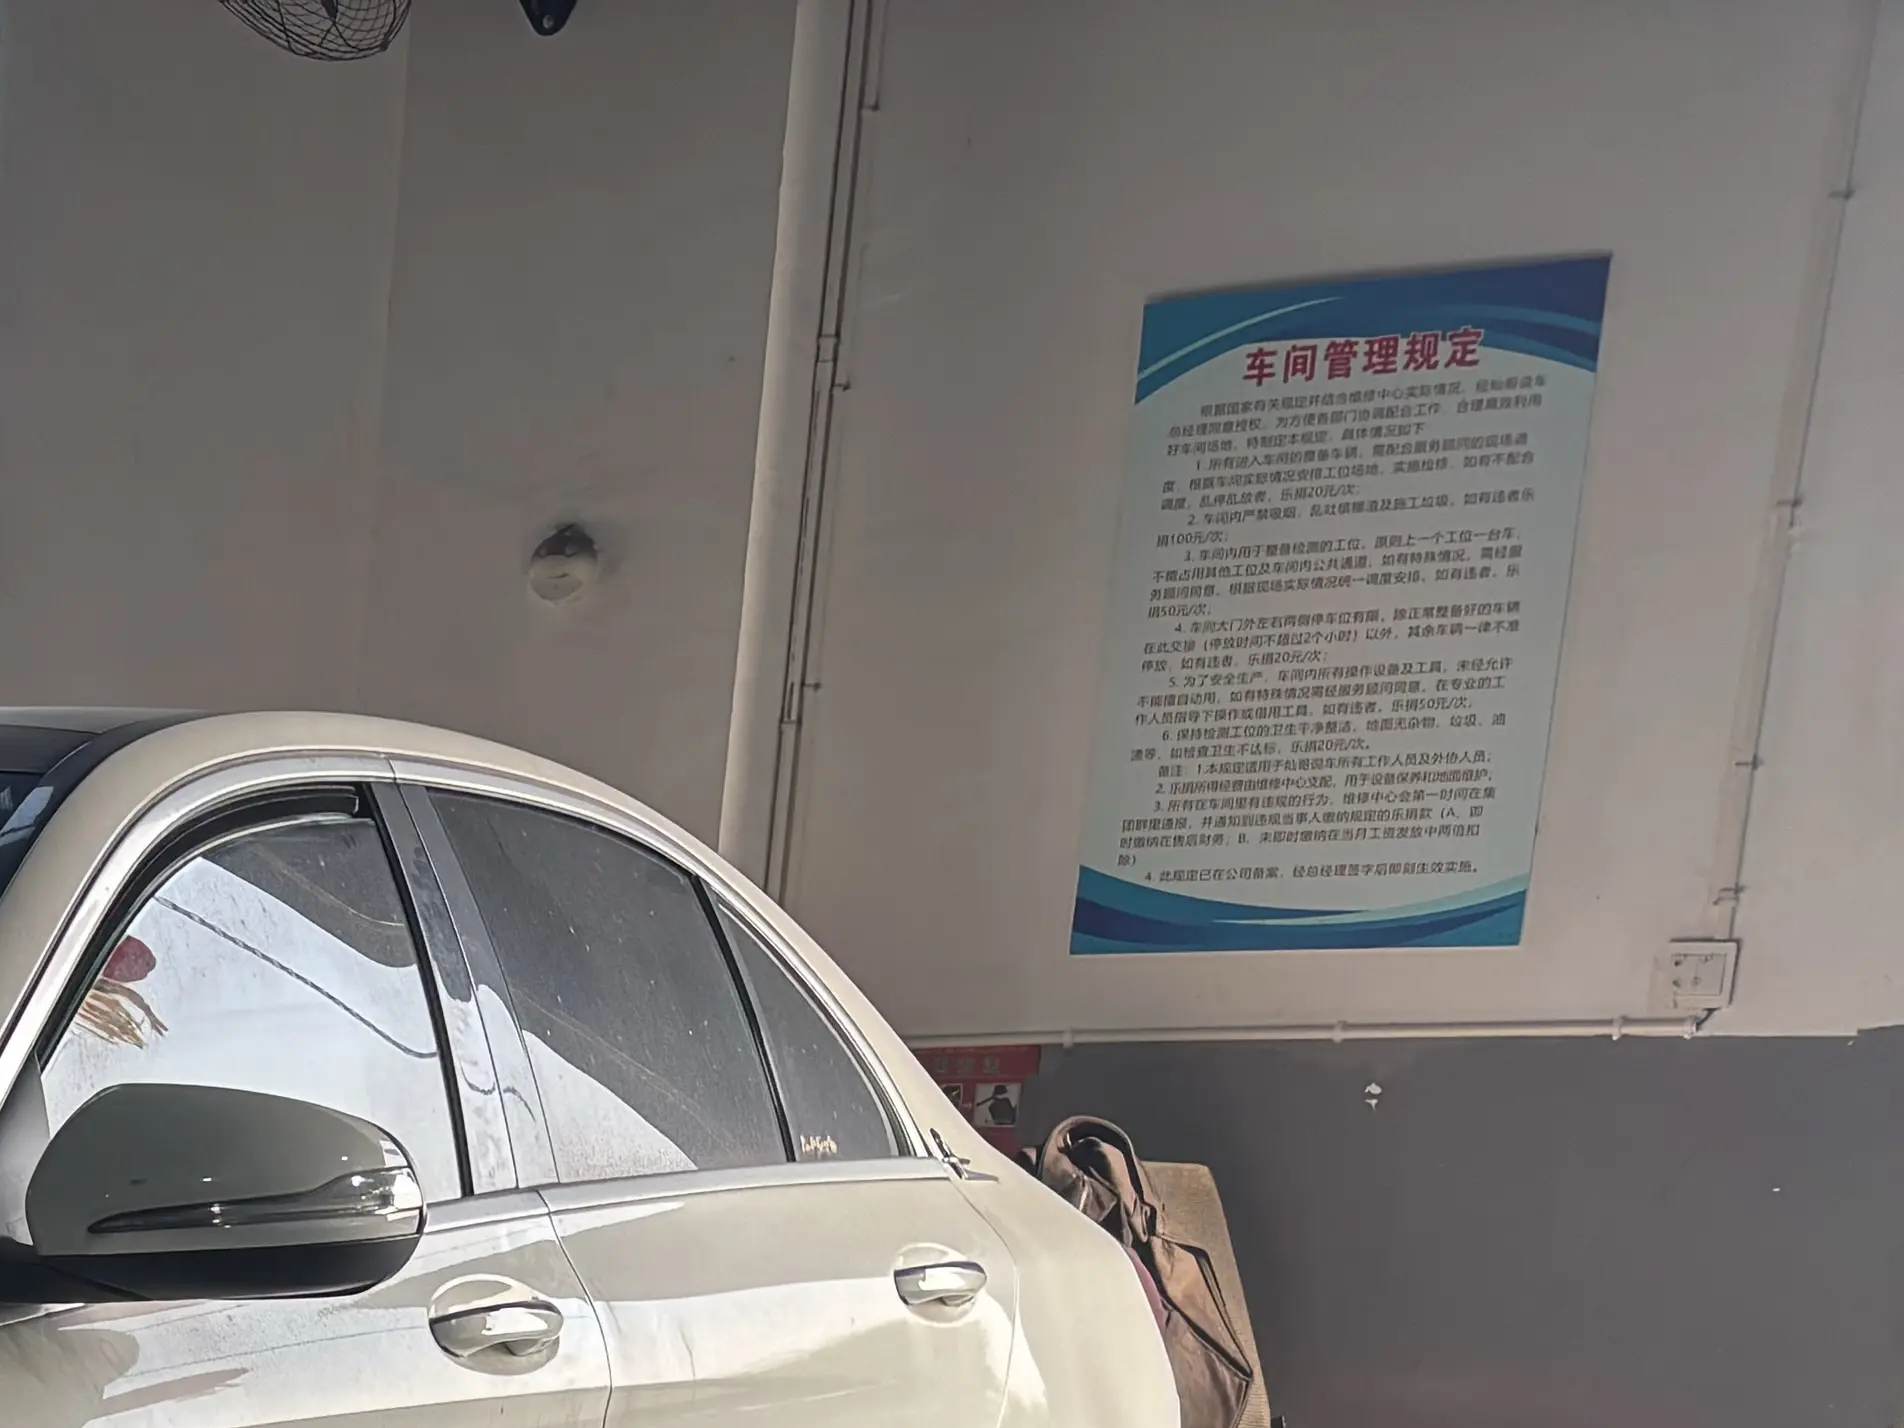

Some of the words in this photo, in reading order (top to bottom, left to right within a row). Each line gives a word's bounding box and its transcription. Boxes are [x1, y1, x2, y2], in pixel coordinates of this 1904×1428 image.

[1241, 323, 1485, 388] 车间管理规定
